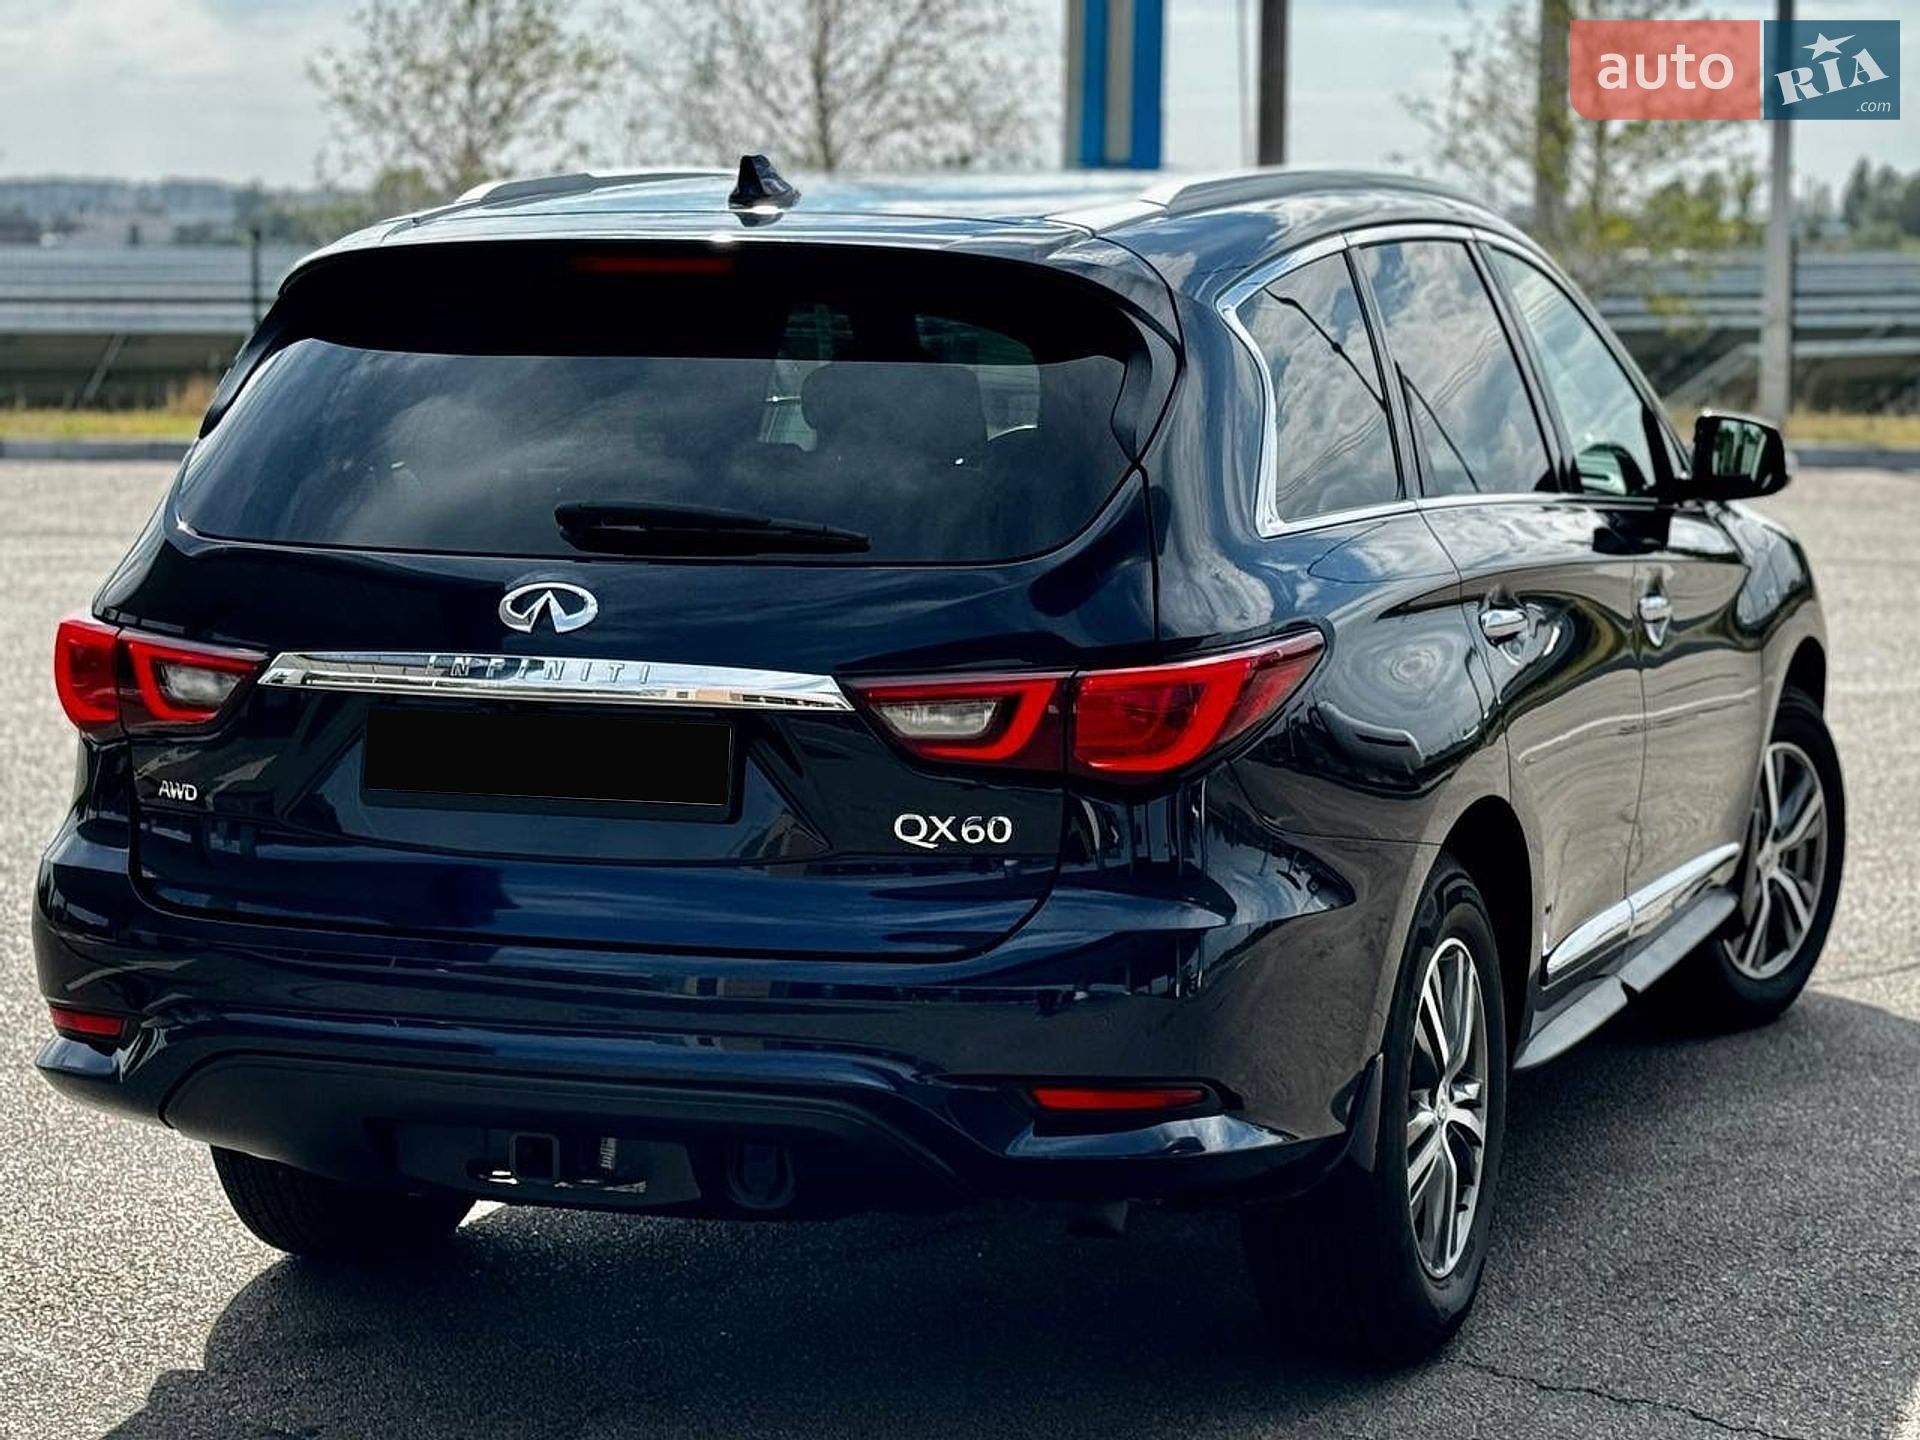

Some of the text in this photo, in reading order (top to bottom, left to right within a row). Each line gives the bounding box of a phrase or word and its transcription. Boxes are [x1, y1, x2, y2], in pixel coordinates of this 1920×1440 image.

[424, 655, 650, 684] INFINITI
[158, 780, 198, 801] AWD
[893, 813, 1013, 849] QX60
